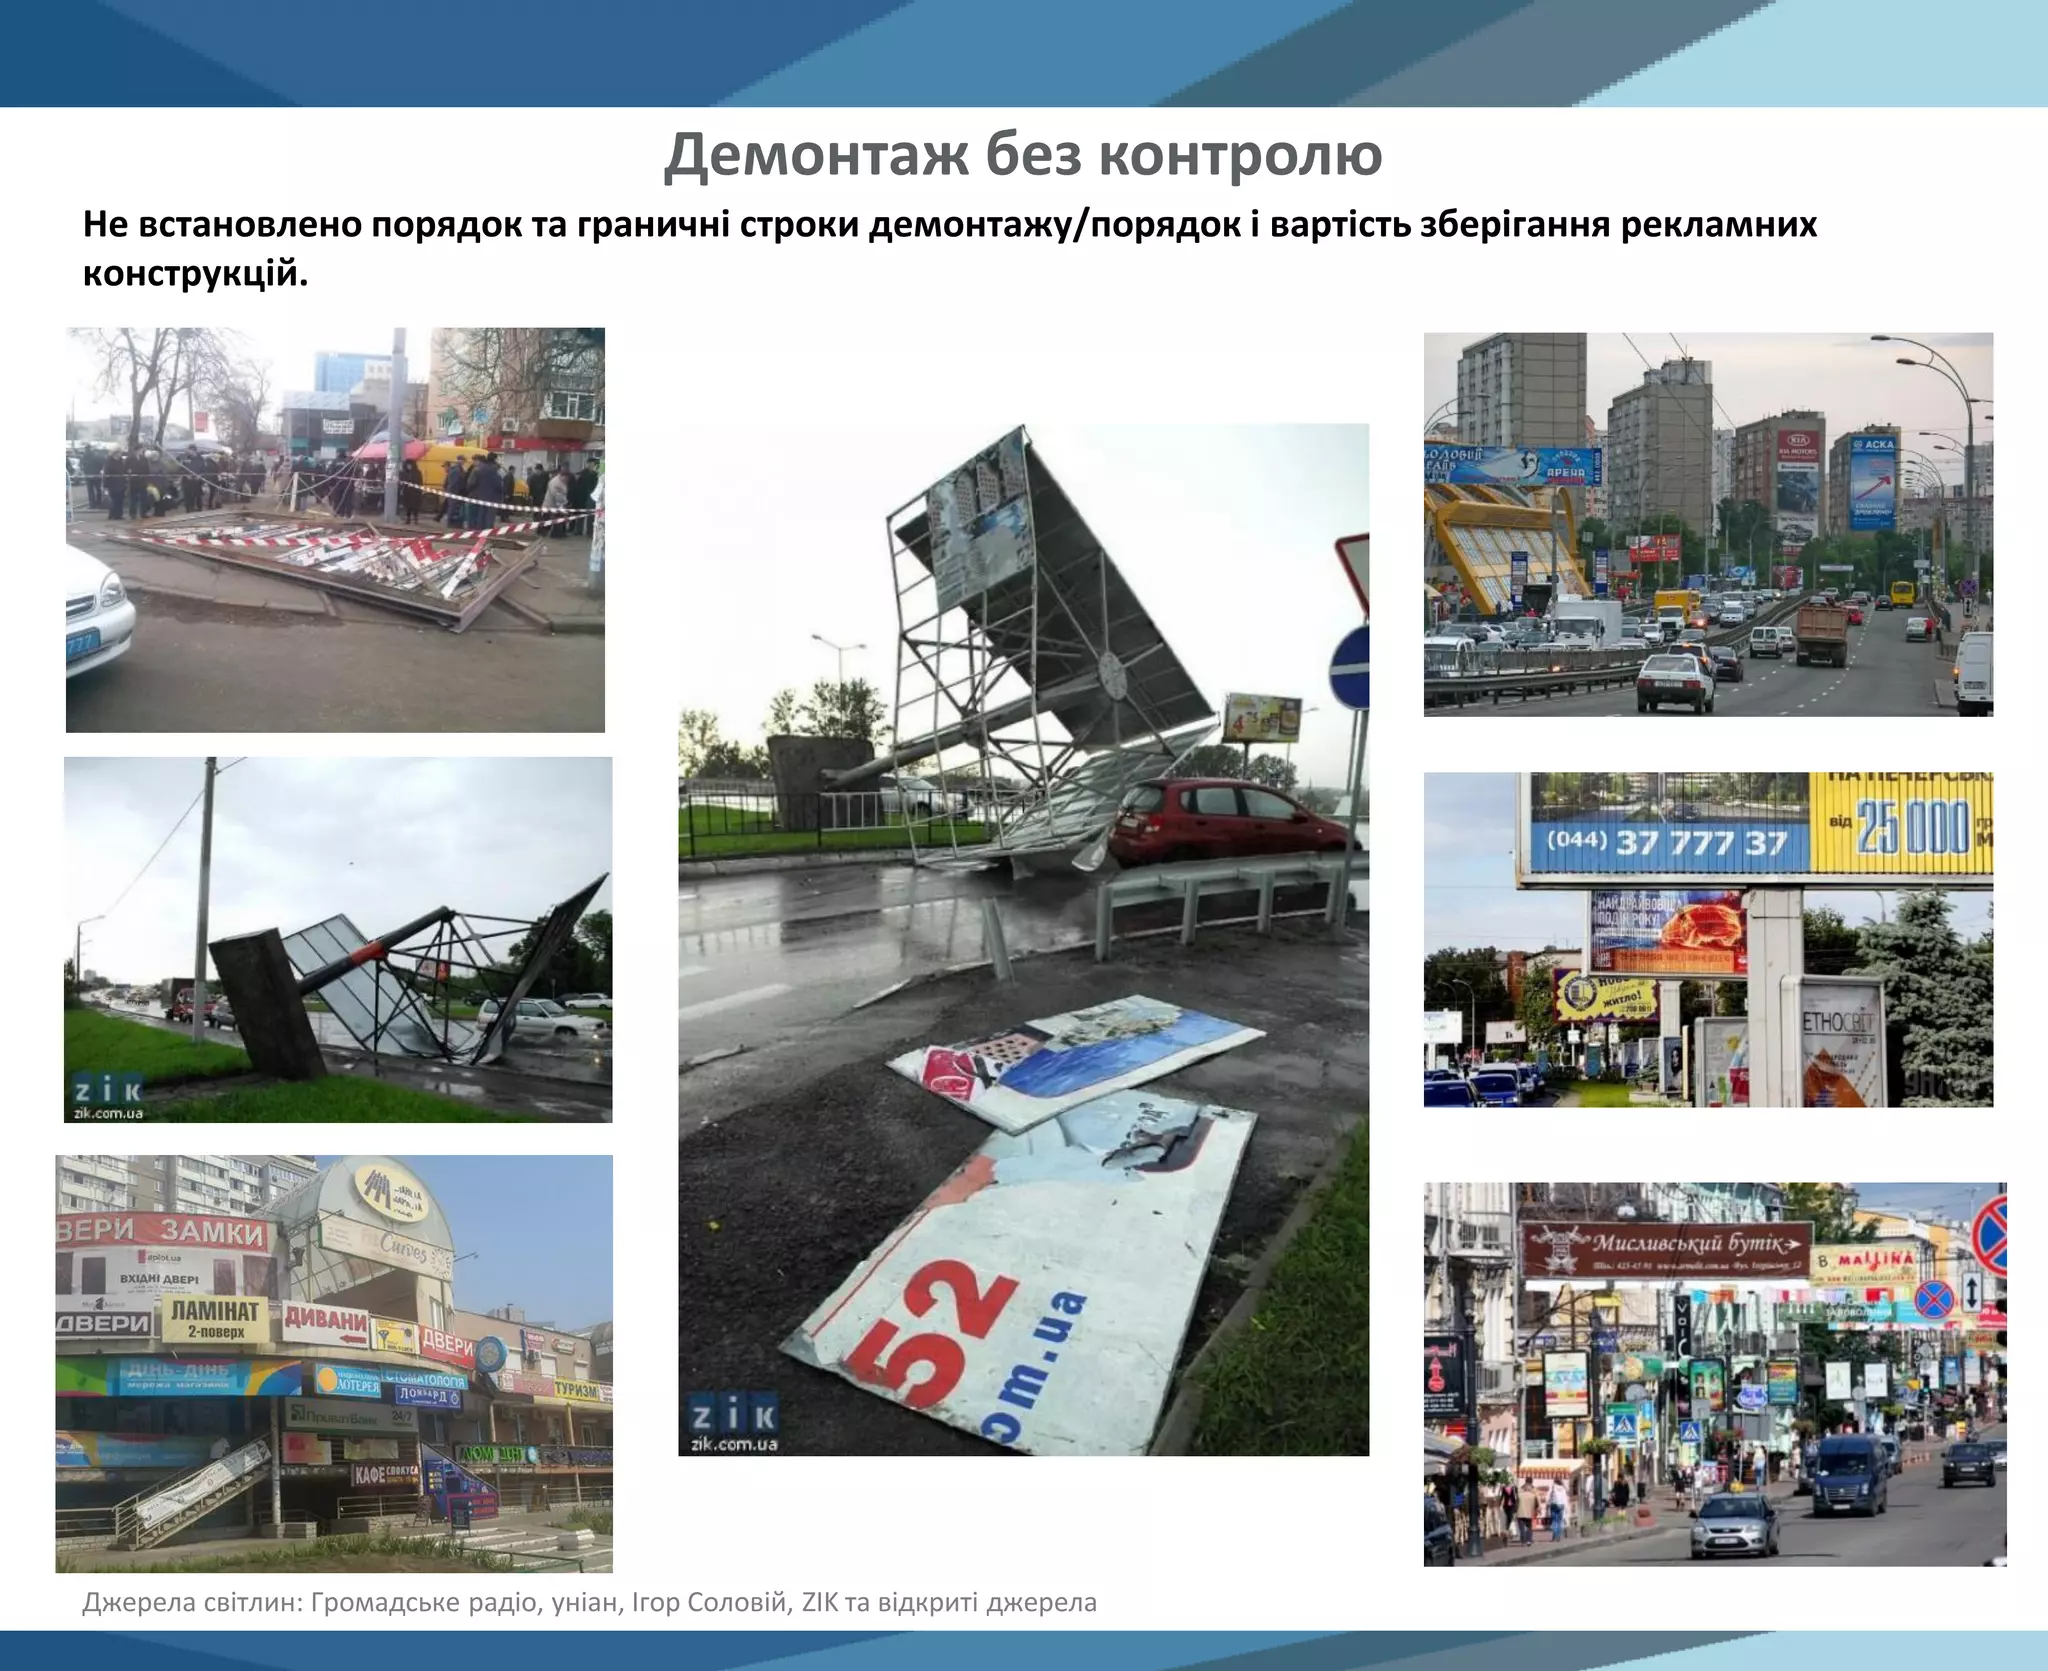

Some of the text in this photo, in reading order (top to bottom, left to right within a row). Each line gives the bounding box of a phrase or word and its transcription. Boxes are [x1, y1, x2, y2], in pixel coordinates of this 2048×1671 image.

[1830, 816, 1853, 829] від
[1857, 799, 1899, 855] 25
[1907, 799, 1970, 855] 000
[1548, 830, 1788, 856] (044) 37 777 37
[160, 1219, 263, 1247] ЗАМКИ
[1592, 1231, 1789, 1257] Мисливський бутік
[120, 1274, 199, 1285] ВХІДНІ ДВЕРІ
[172, 1301, 259, 1321] ЛАМІНАТ
[285, 1306, 368, 1332] ДИВАНИ
[56, 1315, 149, 1332] ДВЕРИ
[188, 1324, 245, 1340] 2-поверх
[423, 1327, 474, 1357] ДВЕРИ
[843, 1259, 1020, 1411] 52
[128, 1363, 229, 1378] ДІНЬ-ДІНЬ
[337, 1378, 380, 1393] ЛОТЕРЕЯ
[400, 1387, 447, 1402] ЛОМБАРД
[555, 1381, 597, 1398] ТУРИЗМ
[307, 1410, 378, 1426] ПриватБанк
[356, 1465, 386, 1484] КАФЕ
